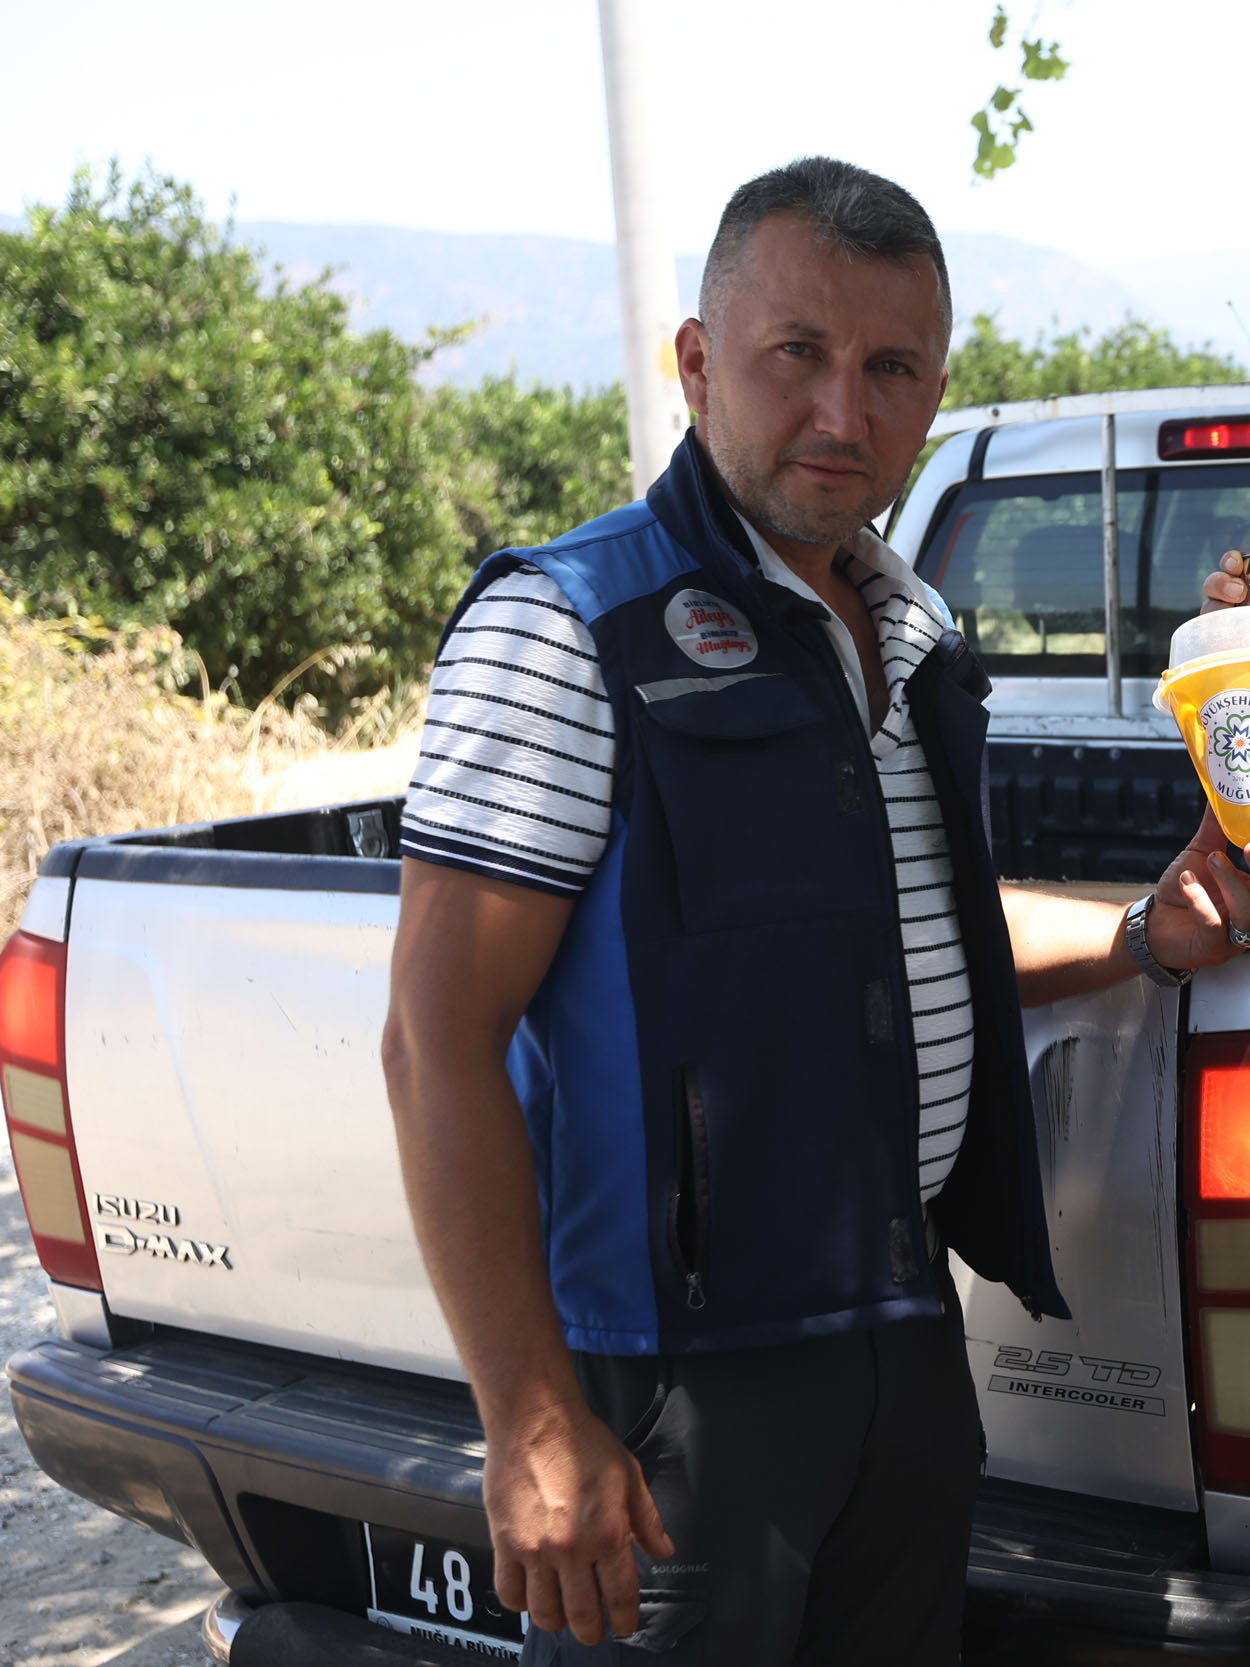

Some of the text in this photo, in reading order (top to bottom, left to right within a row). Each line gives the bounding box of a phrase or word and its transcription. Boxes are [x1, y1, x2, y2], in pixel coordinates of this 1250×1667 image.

[93, 1192, 180, 1228] ISUZU
[96, 1222, 234, 1272] D-MAX
[994, 1345, 1162, 1388] 2.5 TD
[1008, 1381, 1146, 1410] INTERCOOLER
[410, 1543, 474, 1623] 48
